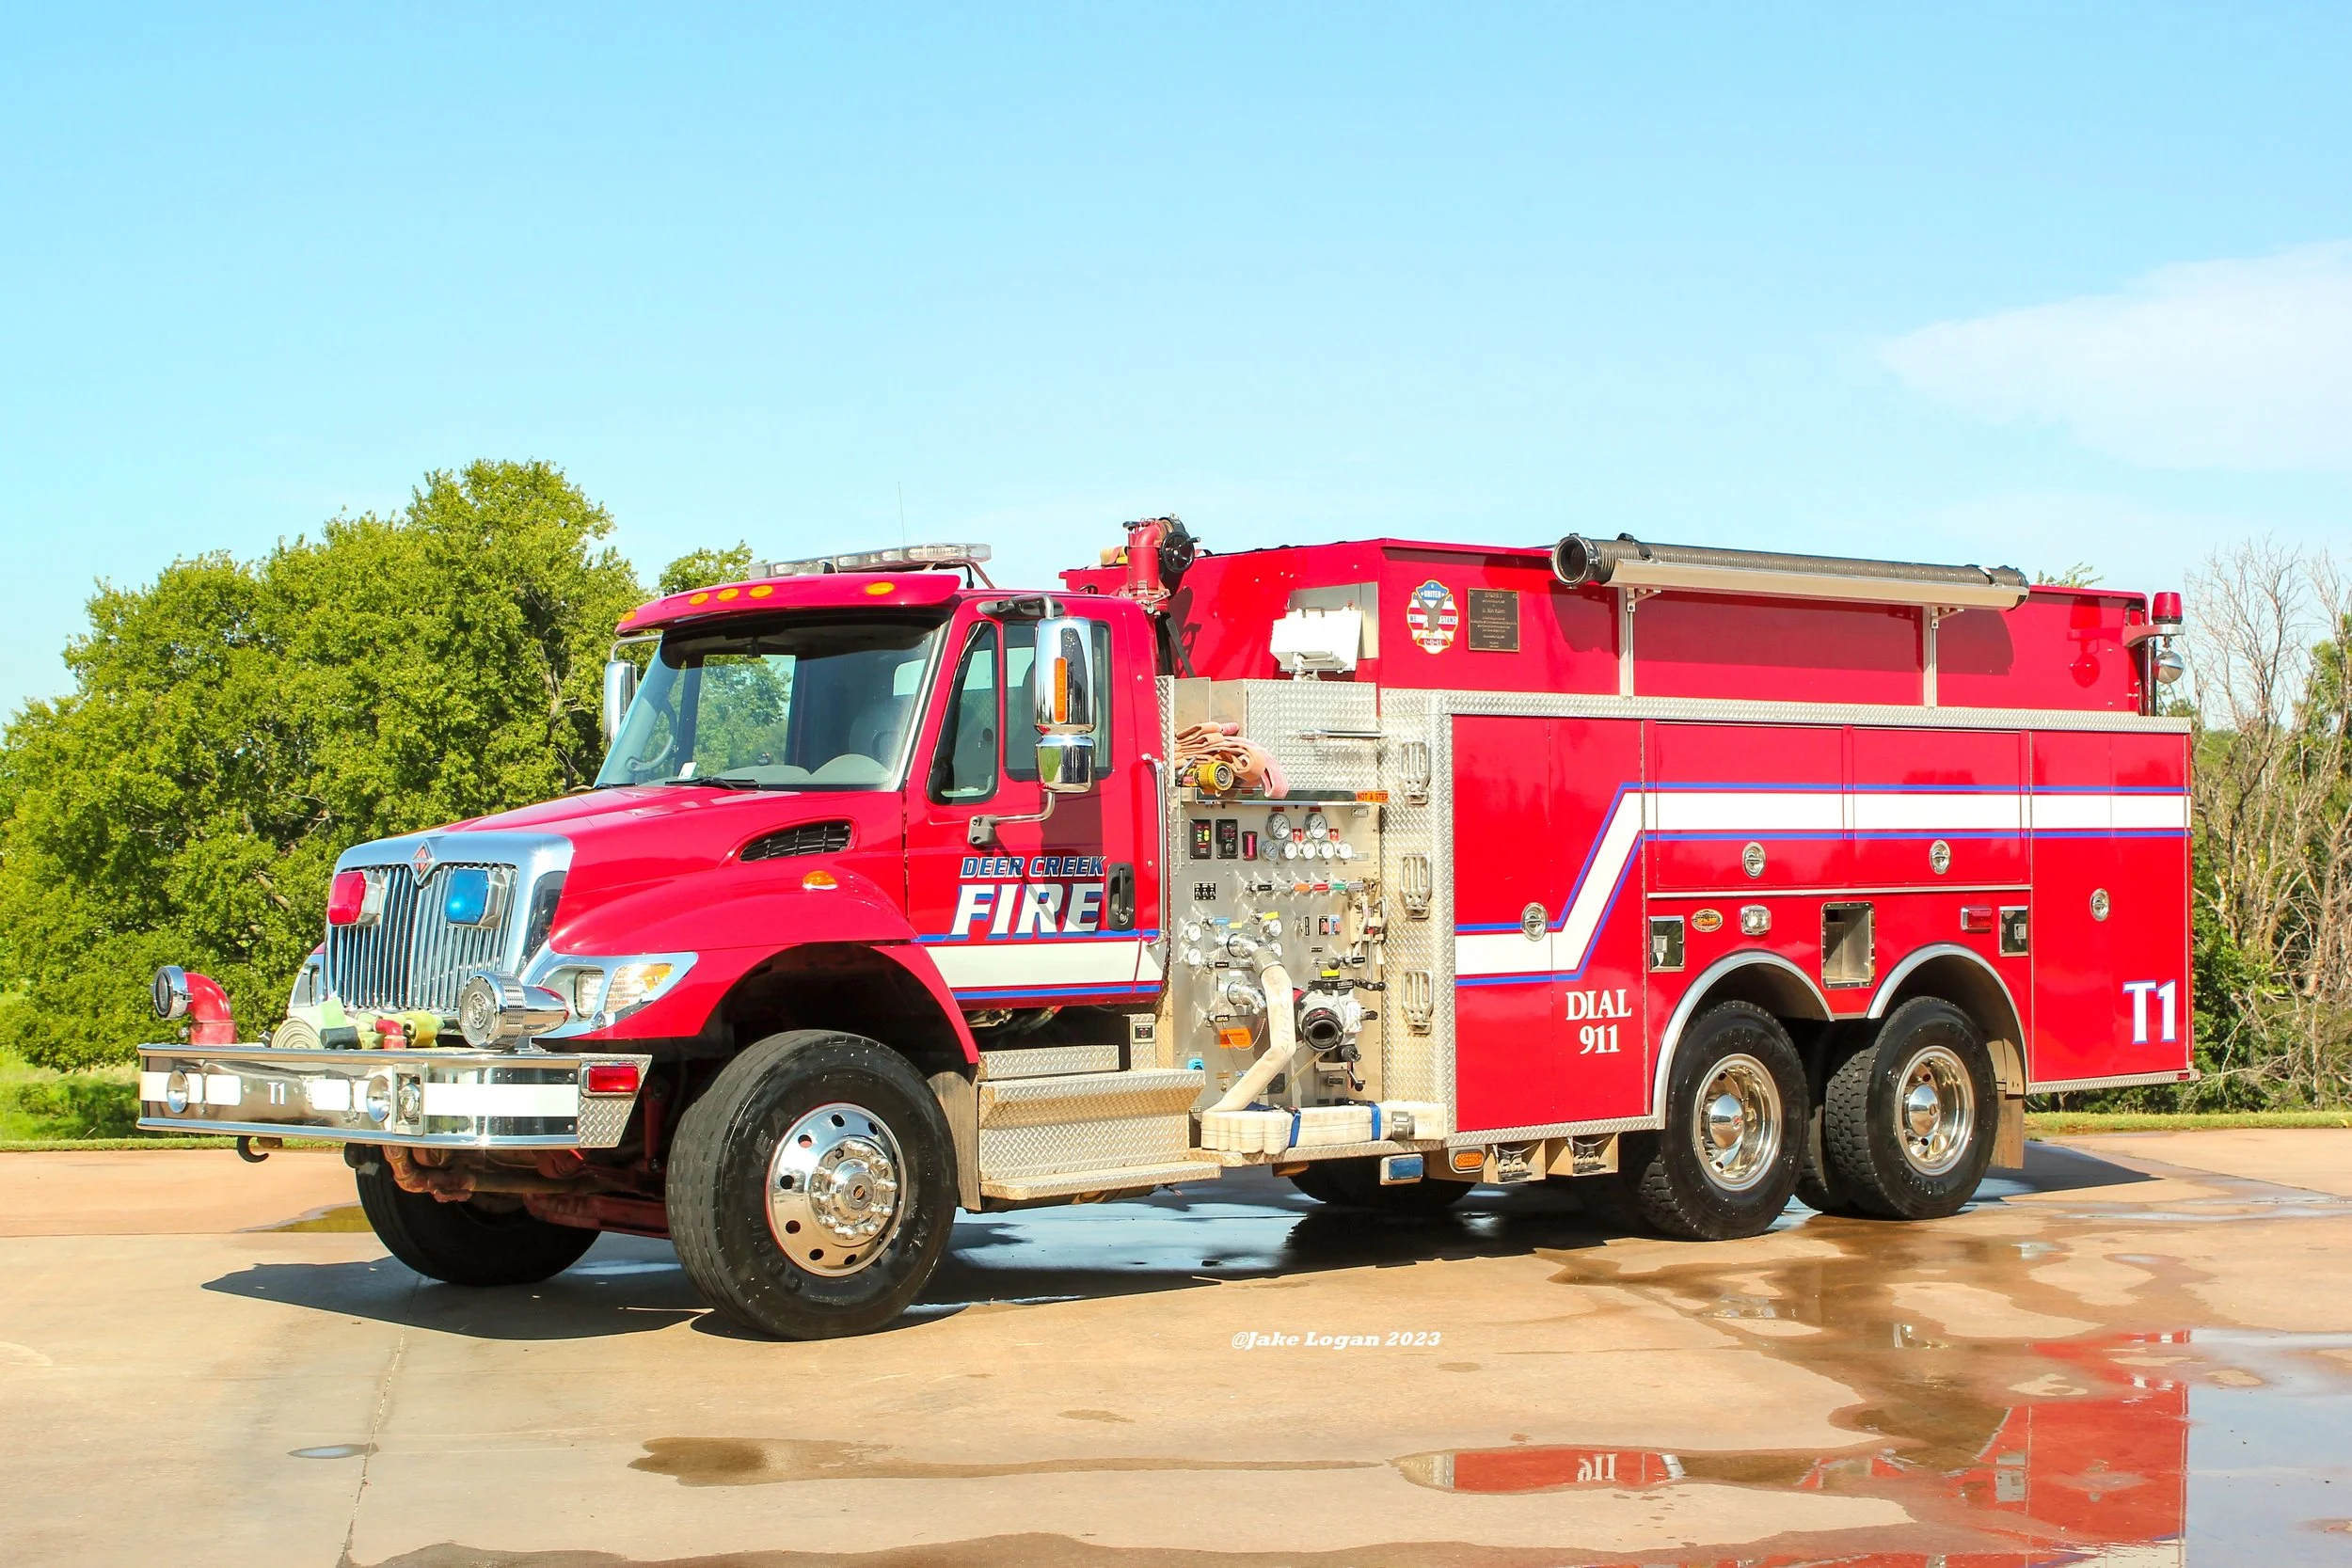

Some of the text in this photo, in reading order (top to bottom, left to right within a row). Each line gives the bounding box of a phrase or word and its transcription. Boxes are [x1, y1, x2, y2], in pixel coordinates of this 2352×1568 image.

[960, 855, 1106, 879] DEER CREEK
[946, 883, 1104, 940] FIRE
[1565, 989, 1632, 1021] DIAL
[2122, 979, 2177, 1044] T1
[1579, 1023, 1621, 1054] 911
[267, 1082, 286, 1105] T1
